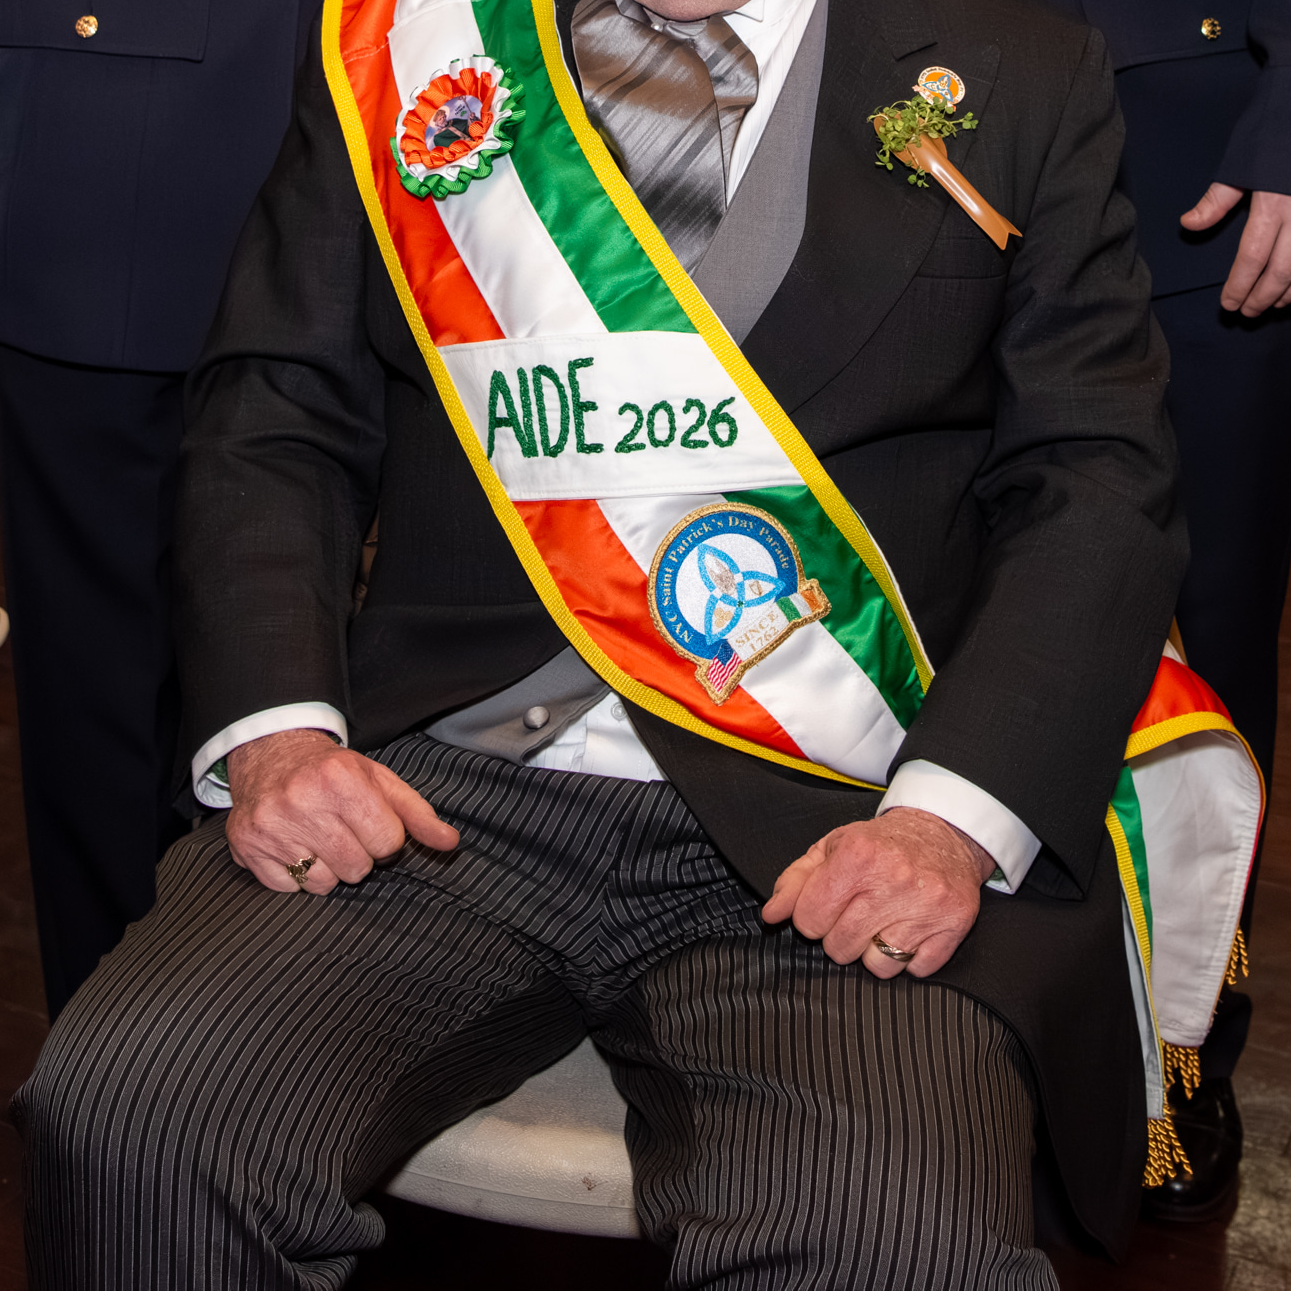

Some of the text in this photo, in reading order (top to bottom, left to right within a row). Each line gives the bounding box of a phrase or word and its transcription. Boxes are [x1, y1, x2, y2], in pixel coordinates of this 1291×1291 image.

[487, 357, 738, 461] AIDE 2026
[661, 516, 790, 644] NYC Saint Patrick's Day Parade
[736, 610, 779, 648] SINCE
[750, 627, 779, 652] 1762
